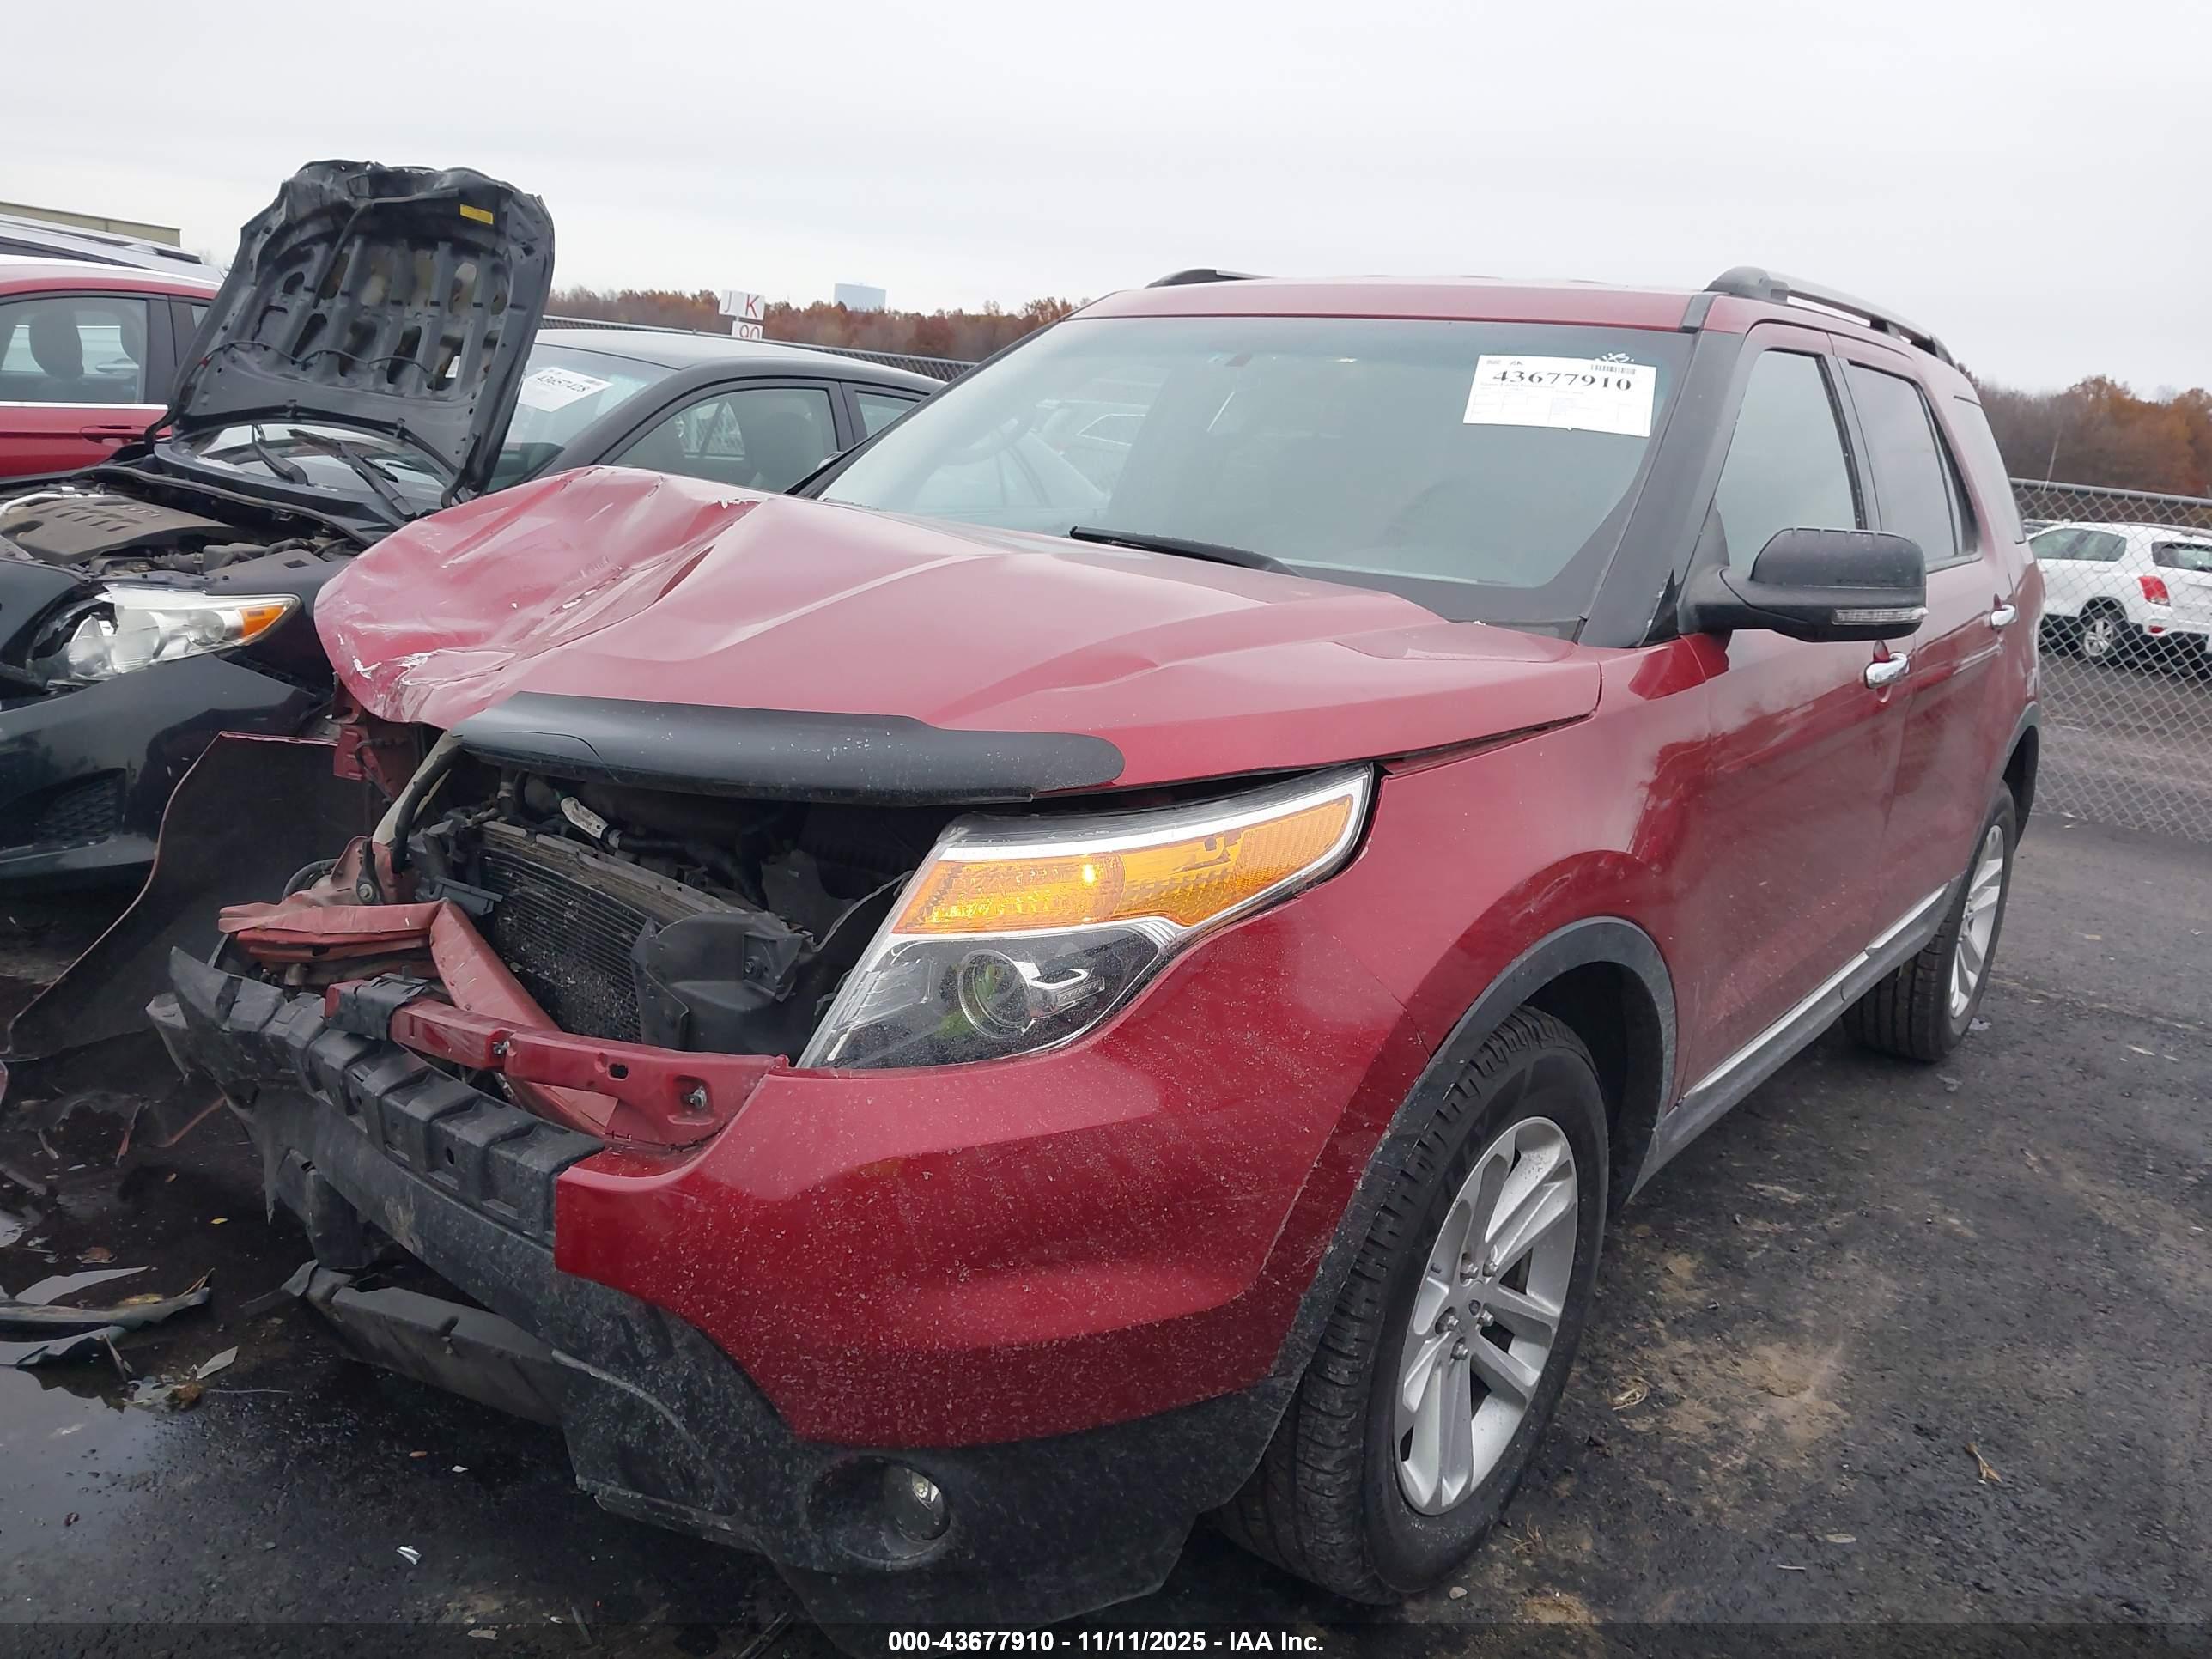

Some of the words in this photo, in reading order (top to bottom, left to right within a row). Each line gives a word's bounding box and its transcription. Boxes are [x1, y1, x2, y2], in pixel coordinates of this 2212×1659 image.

[724, 291, 732, 313] J
[744, 294, 760, 318] K
[1492, 369, 1632, 392] 43677910
